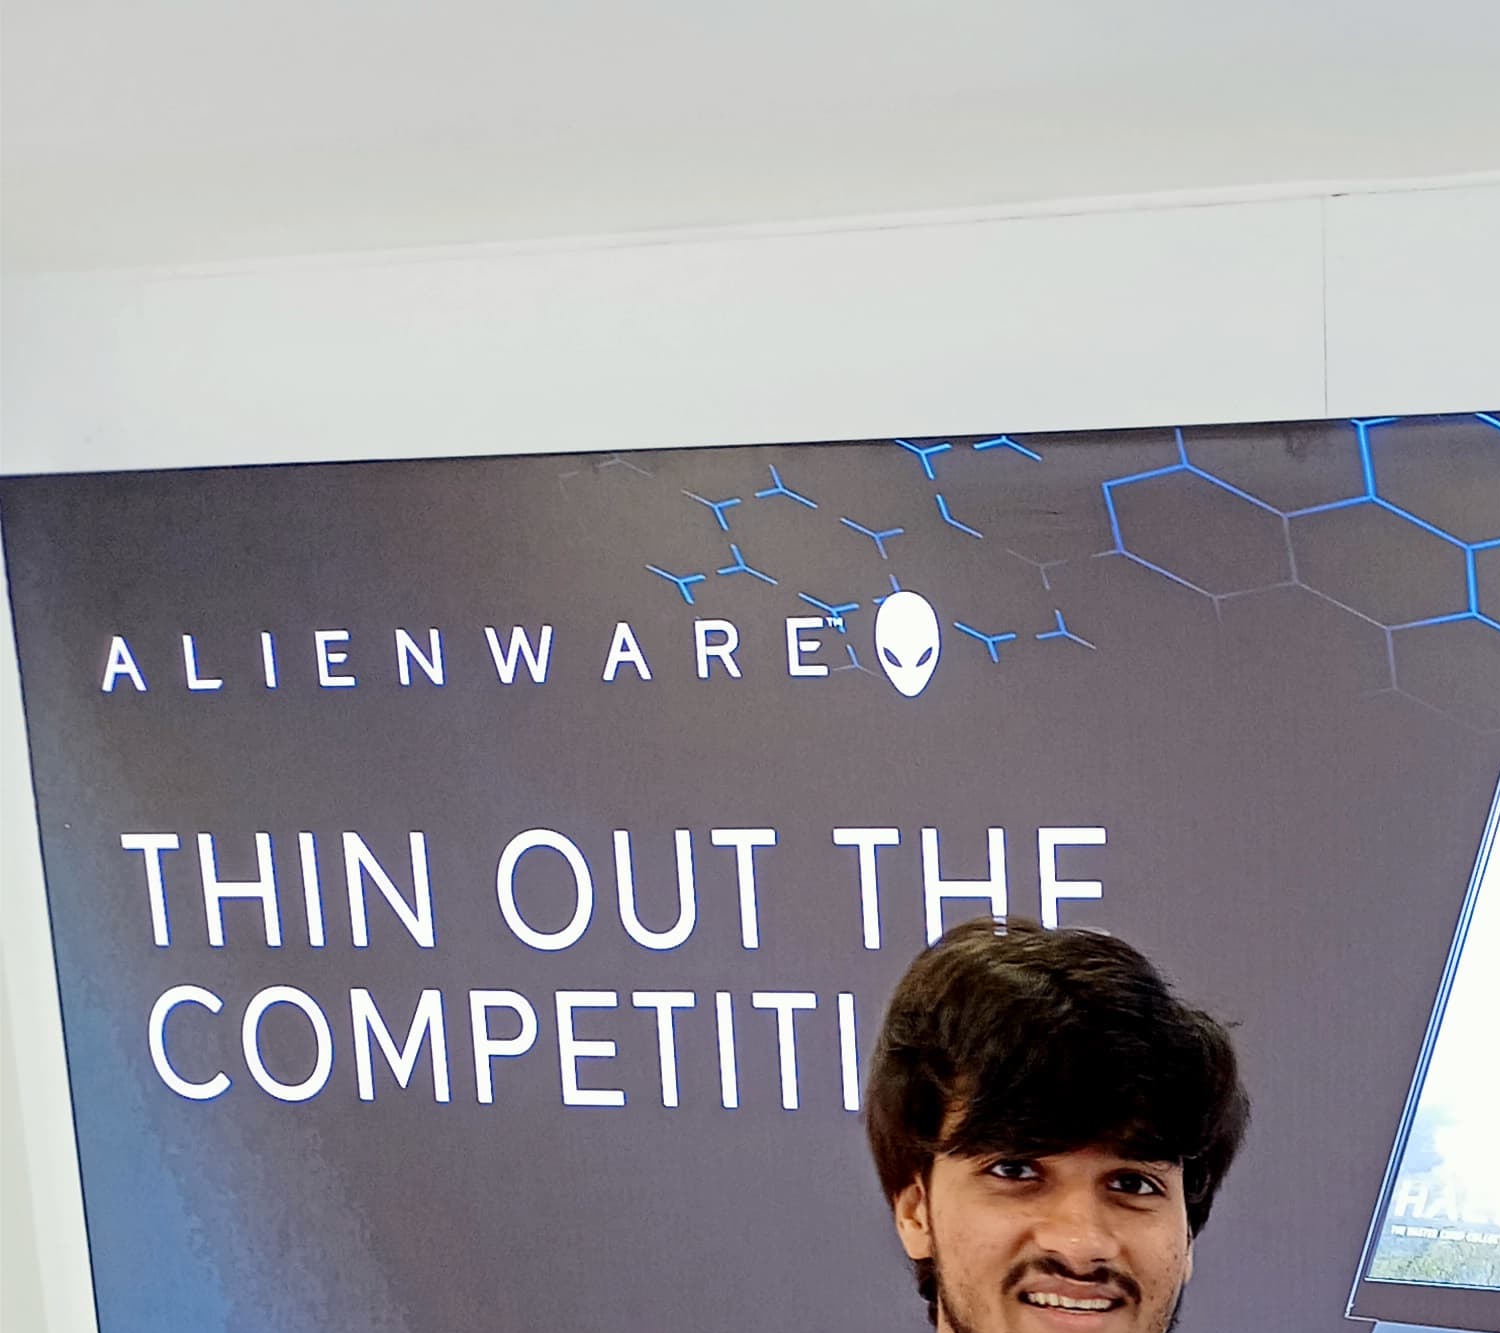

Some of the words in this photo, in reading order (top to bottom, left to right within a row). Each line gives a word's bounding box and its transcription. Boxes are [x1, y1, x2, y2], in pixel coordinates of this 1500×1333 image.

[122, 832, 437, 948] THIN
[495, 828, 776, 951] OUT
[832, 827, 1108, 950] THE
[148, 984, 860, 1111] COMPETITI
